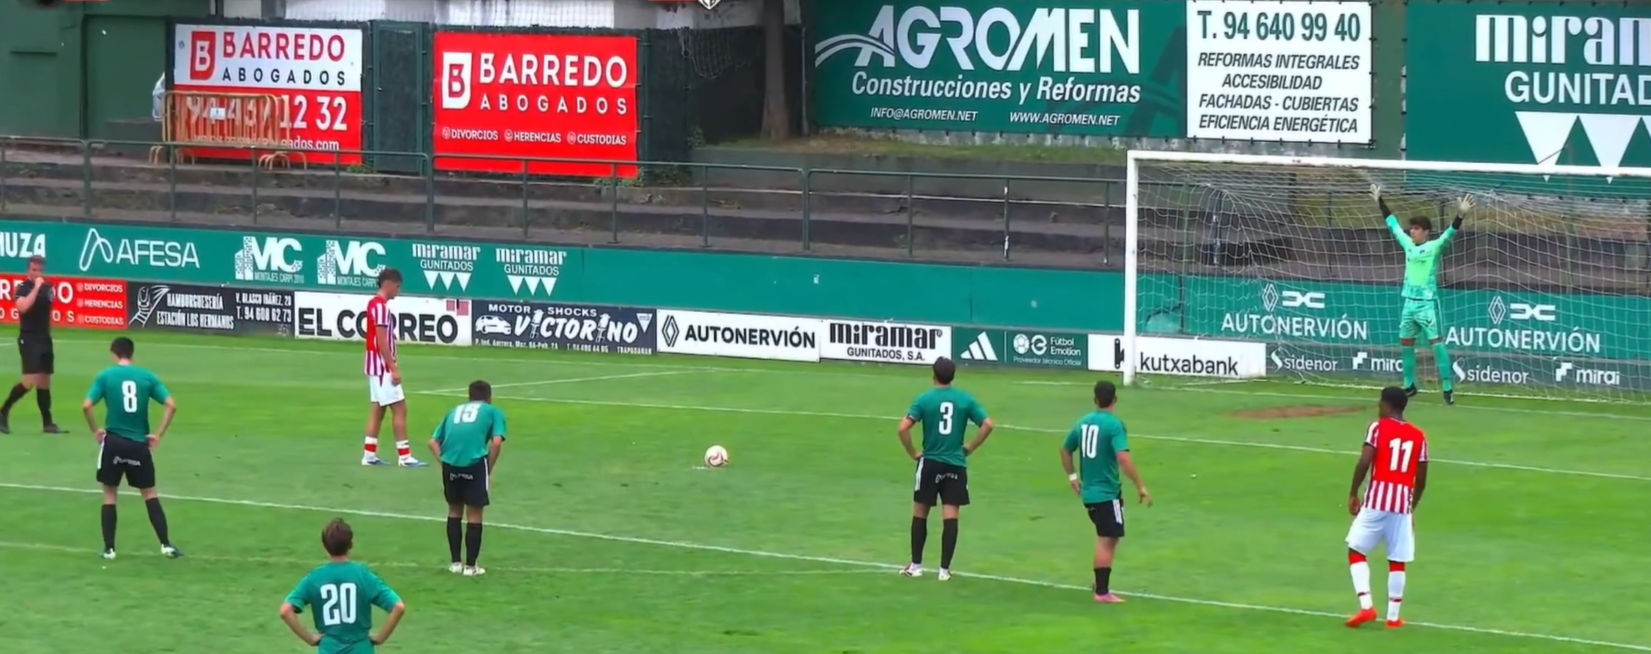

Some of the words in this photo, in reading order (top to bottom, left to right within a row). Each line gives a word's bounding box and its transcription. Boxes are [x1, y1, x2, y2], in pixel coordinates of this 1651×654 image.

[1197, 10, 1217, 39] T.
[1223, 11, 1250, 40] 94
[1256, 12, 1295, 41] 640
[1301, 12, 1327, 42] 99
[1334, 13, 1361, 42] 40
[223, 31, 345, 62] BARREDO
[853, 4, 1140, 74] AGROMEN
[479, 52, 627, 88] BARREDO
[1198, 52, 1273, 68] REFORMAS
[1275, 54, 1360, 70] INTEGRALES
[222, 67, 345, 86] ABOGADOS
[1222, 73, 1323, 90] ACCESIBILIDAD
[852, 70, 1011, 99] Construcciones
[1019, 81, 1031, 104] y
[1036, 76, 1141, 103] Reformas
[480, 93, 627, 114] ABOGADOS
[1199, 93, 1272, 110] FACHADAS
[1282, 95, 1359, 112] CUBIERTAS
[280, 95, 307, 129] 12
[315, 96, 347, 131] 32
[870, 107, 978, 122] INFO@AGROMEN.NET
[1010, 111, 1120, 126] WWW.AGROMEN.NET
[1199, 114, 1270, 131] EFICIENCIA
[1273, 114, 1358, 133] ENERGÉTICA
[451, 128, 498, 141] DIVORCIOS
[514, 131, 561, 143] HERENCIAS
[577, 133, 626, 145] CUSTODIAS
[116, 238, 200, 268] AFESA
[250, 236, 303, 273] MC
[412, 243, 481, 261] miramar
[495, 248, 567, 265] miramar
[420, 259, 473, 271] GUNITADOS
[504, 264, 559, 276] GUNITADOS
[244, 306, 254, 321] 94
[489, 304, 531, 314] MOTOR
[547, 306, 597, 317] SHOCKS
[298, 307, 332, 338] EL
[1221, 313, 1367, 340] AUTONERVIÓN
[685, 324, 815, 349] AUTONERVIÓN
[829, 322, 942, 350] miramar
[1051, 336, 1075, 347] Fútbol
[1445, 326, 1600, 353] AUTONERVIÓN
[846, 347, 905, 361] GUNITADOS,
[907, 350, 926, 361] S.A.
[1013, 355, 1041, 365] Proveedor
[1050, 347, 1081, 356] Emotion
[1140, 352, 1239, 376] kutxabank
[1283, 354, 1338, 371] sidenor
[1467, 365, 1529, 385] sidenor
[1576, 369, 1620, 385] mirai
[122, 380, 137, 413] 8
[938, 402, 953, 435] 3
[1081, 424, 1099, 458] 10
[1389, 438, 1414, 473] 11
[320, 582, 357, 626] 20
